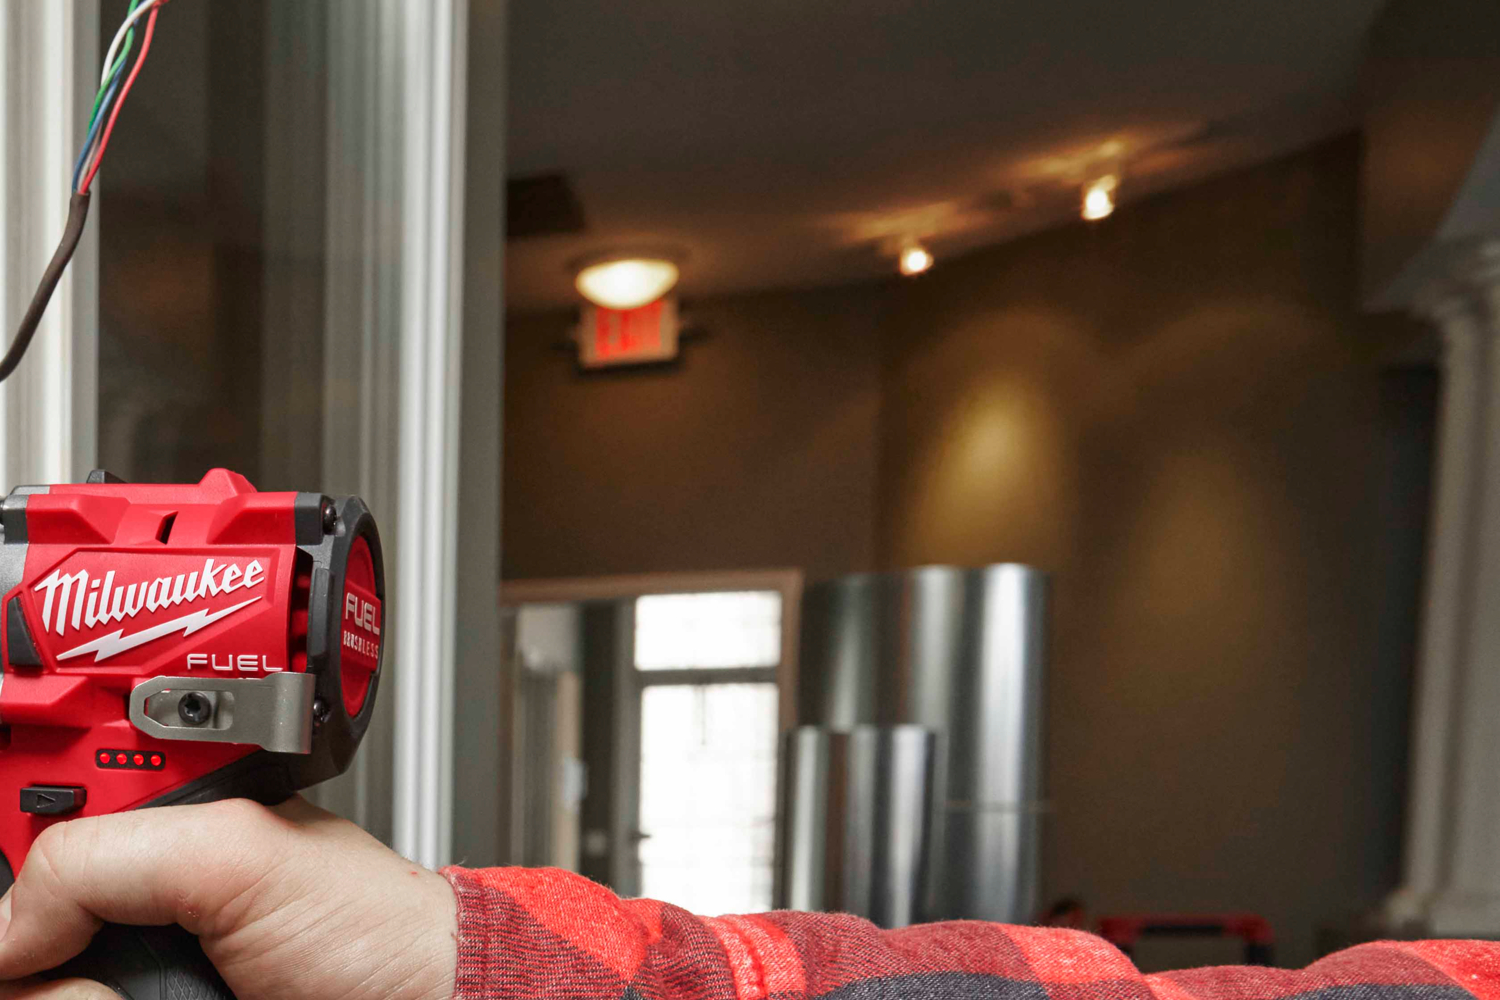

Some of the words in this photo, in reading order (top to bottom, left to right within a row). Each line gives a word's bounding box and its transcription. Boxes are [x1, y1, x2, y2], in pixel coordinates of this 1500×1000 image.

[34, 558, 265, 636] Milwaukee
[345, 592, 380, 636] FUEL
[187, 653, 283, 672] FUEL
